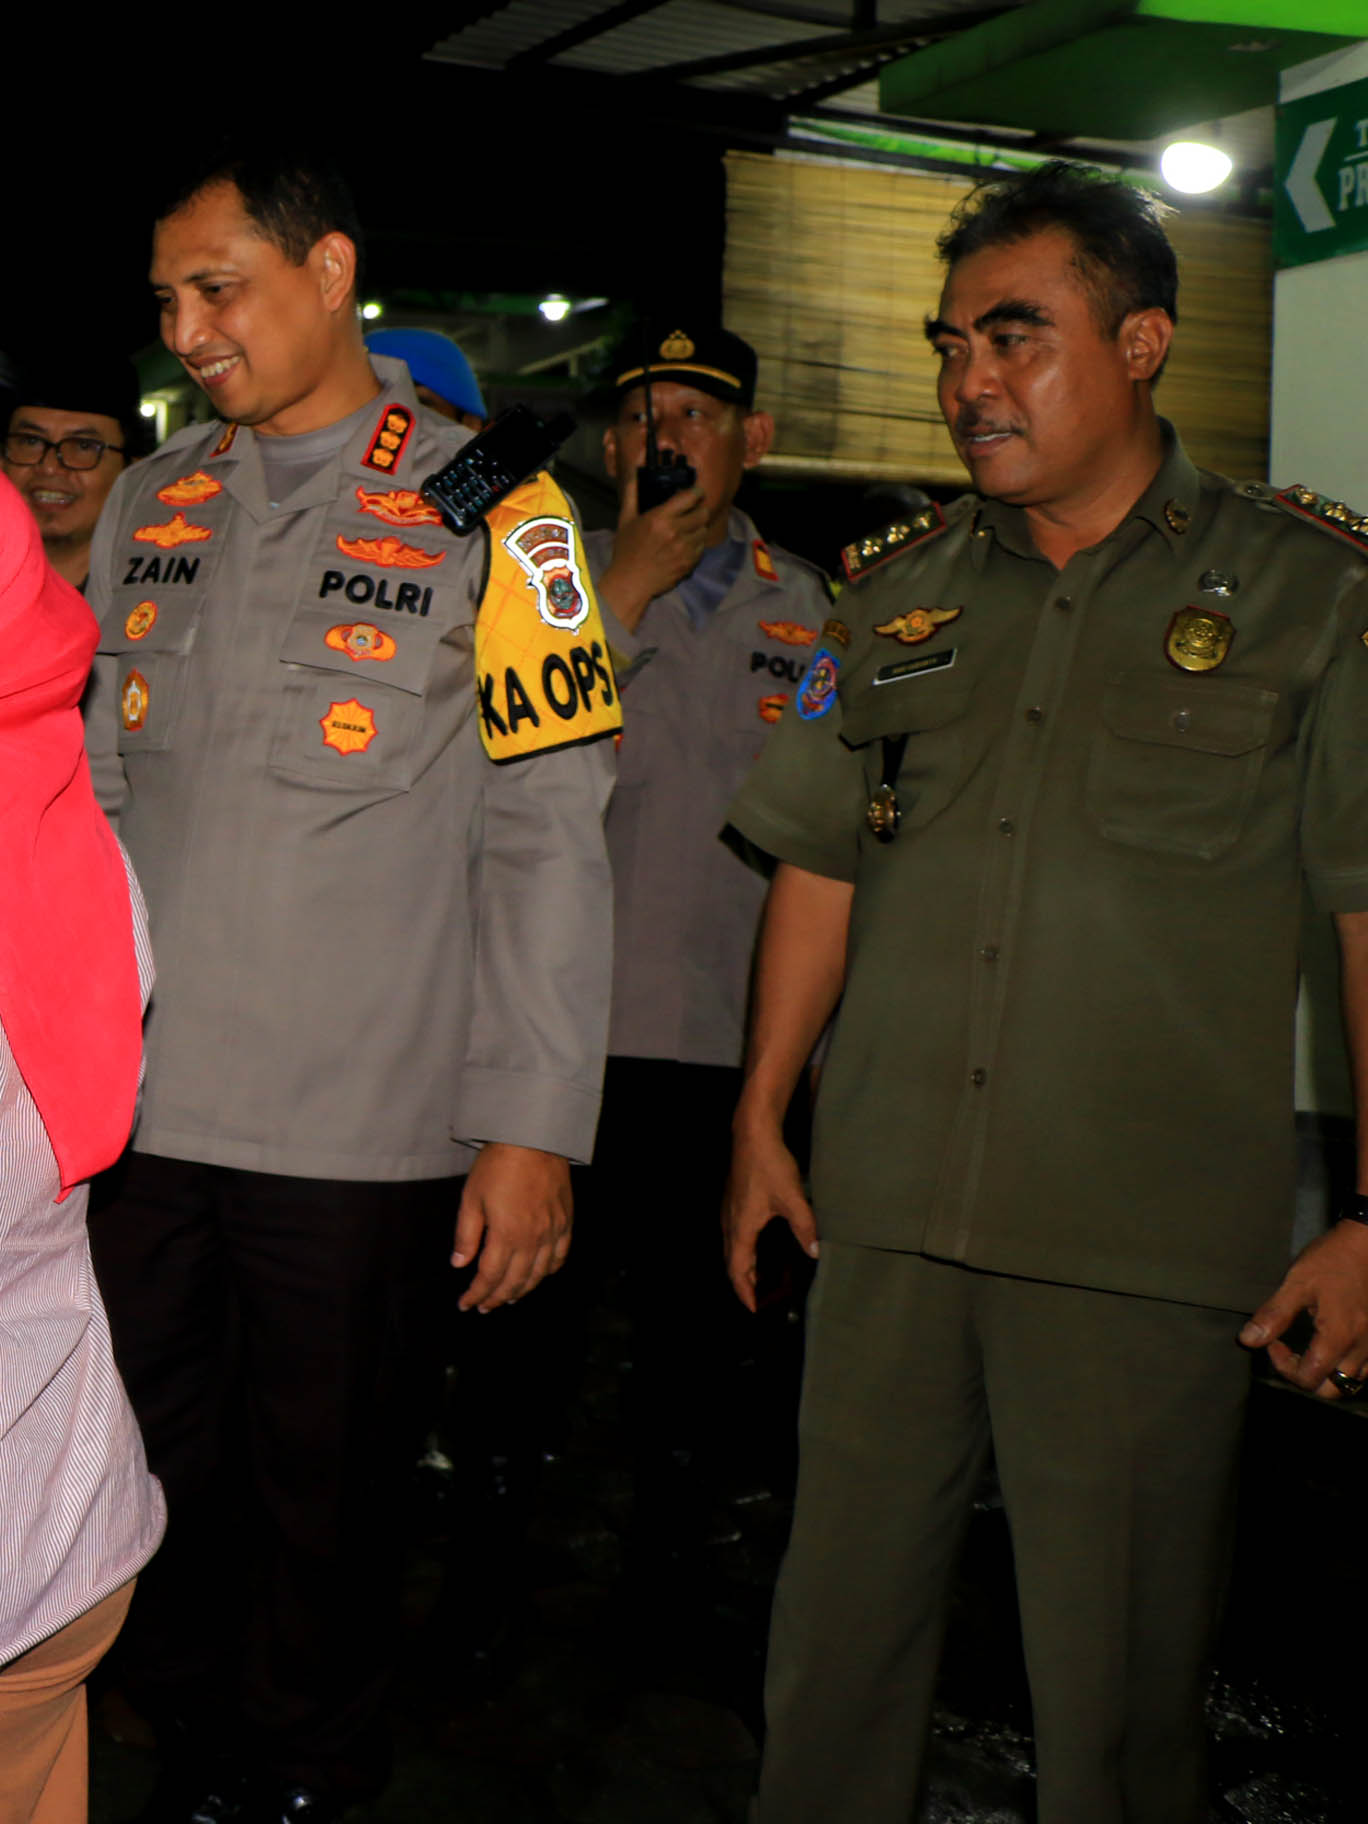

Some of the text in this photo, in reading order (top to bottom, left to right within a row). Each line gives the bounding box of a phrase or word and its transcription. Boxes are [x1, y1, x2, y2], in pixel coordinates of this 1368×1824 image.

[122, 557, 201, 585] ZAIN
[318, 569, 434, 617] POLRI
[750, 651, 806, 683] POL
[477, 640, 614, 740] KA OPS
